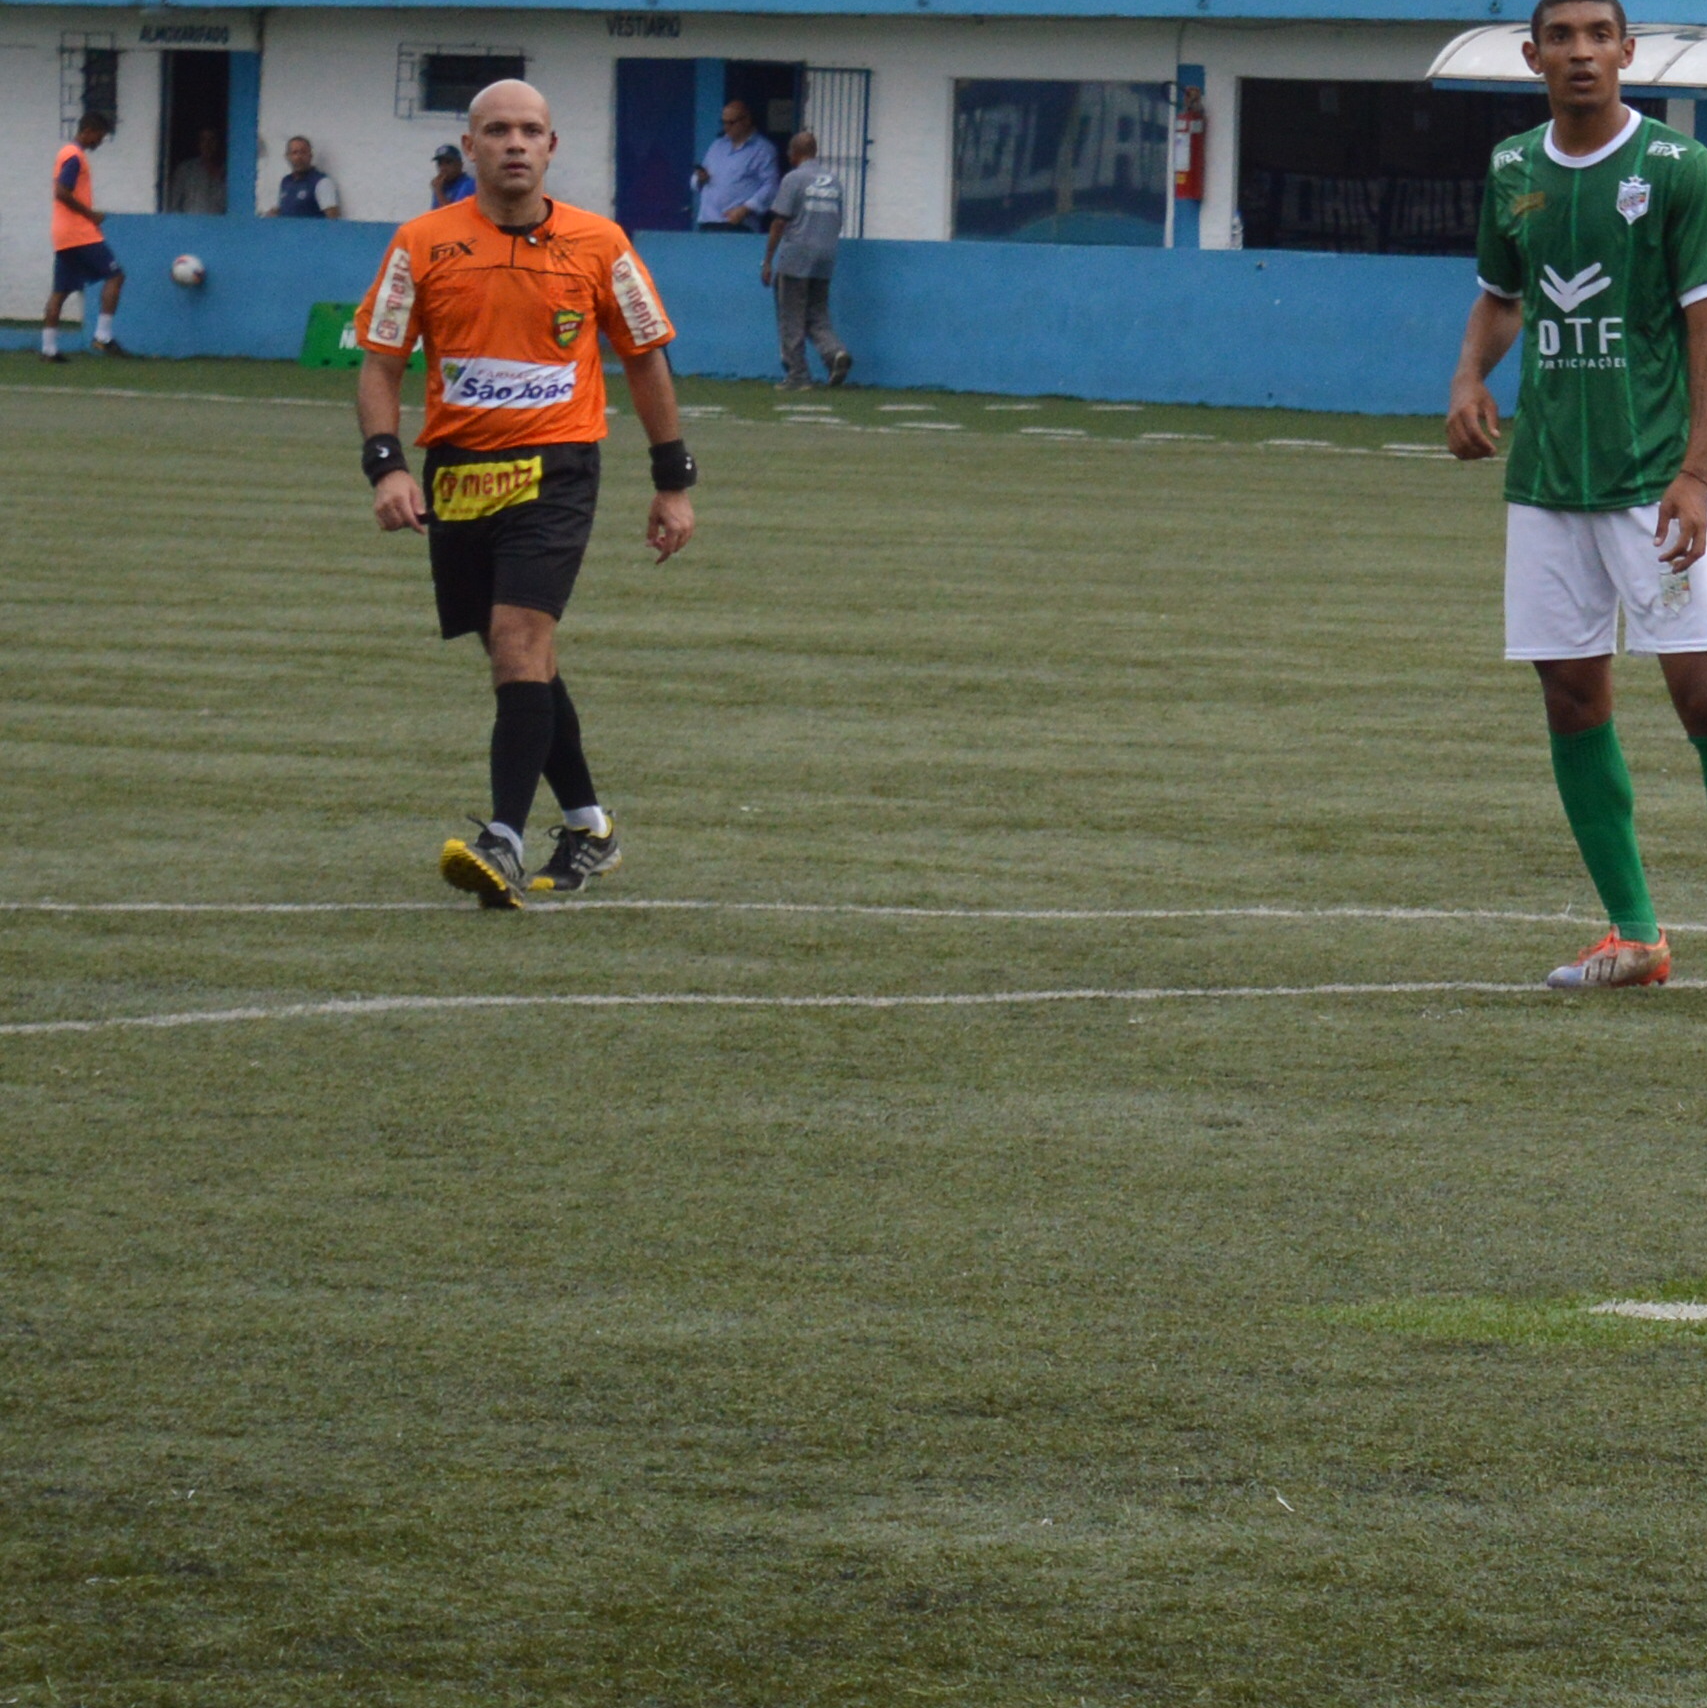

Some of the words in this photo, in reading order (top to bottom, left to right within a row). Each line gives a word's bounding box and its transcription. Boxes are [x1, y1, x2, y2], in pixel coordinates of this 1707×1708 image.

[461, 376, 512, 400] São
[515, 378, 573, 400] João
[463, 465, 533, 496] mentz
